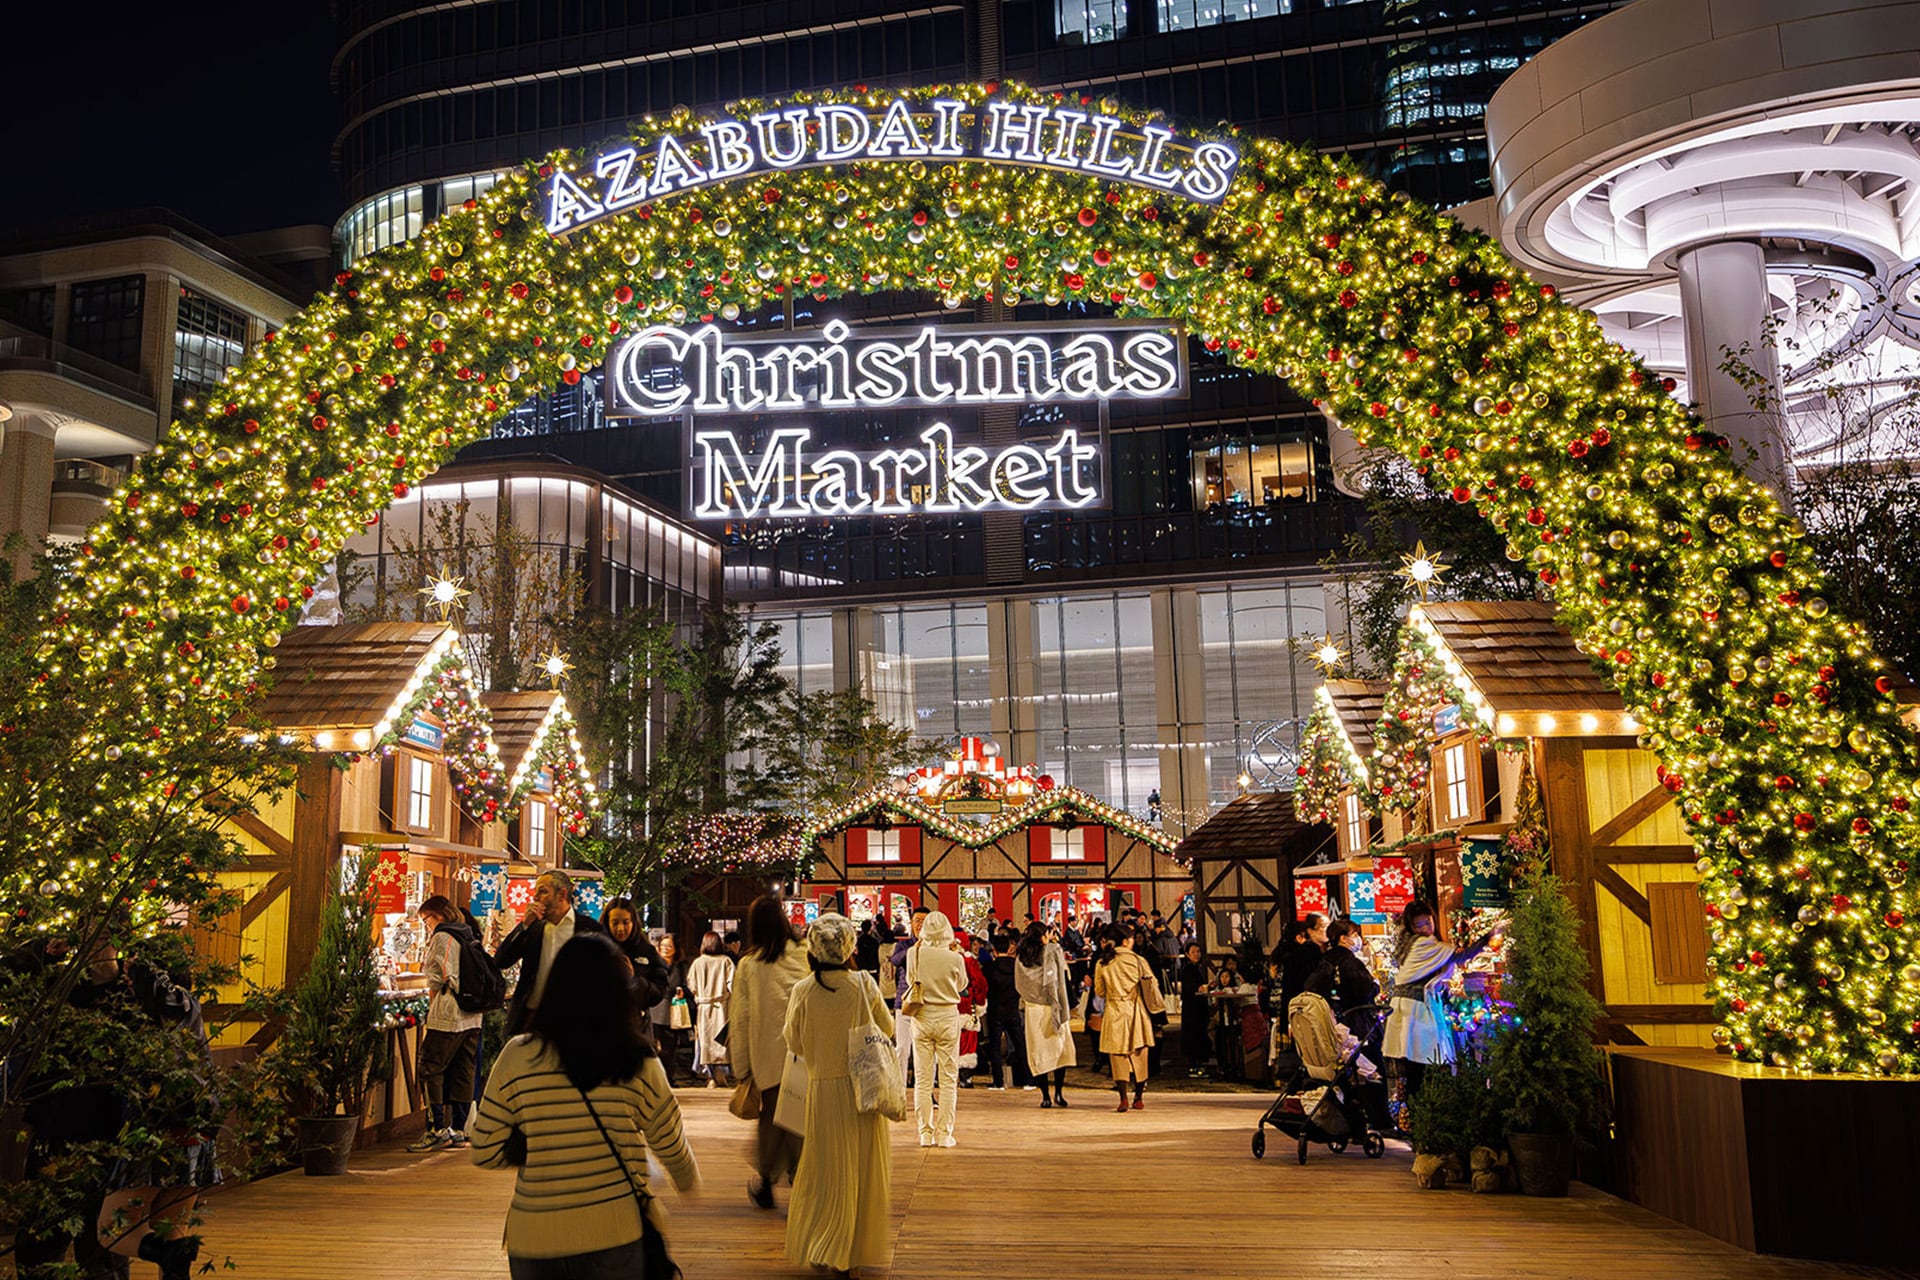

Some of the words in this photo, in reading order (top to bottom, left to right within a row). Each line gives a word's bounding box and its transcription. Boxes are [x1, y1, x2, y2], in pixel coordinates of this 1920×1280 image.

[546, 101, 966, 234] AZABUDAI
[985, 101, 1239, 201] HILLS
[613, 318, 1179, 414] Christmas
[694, 420, 1099, 520] Market
